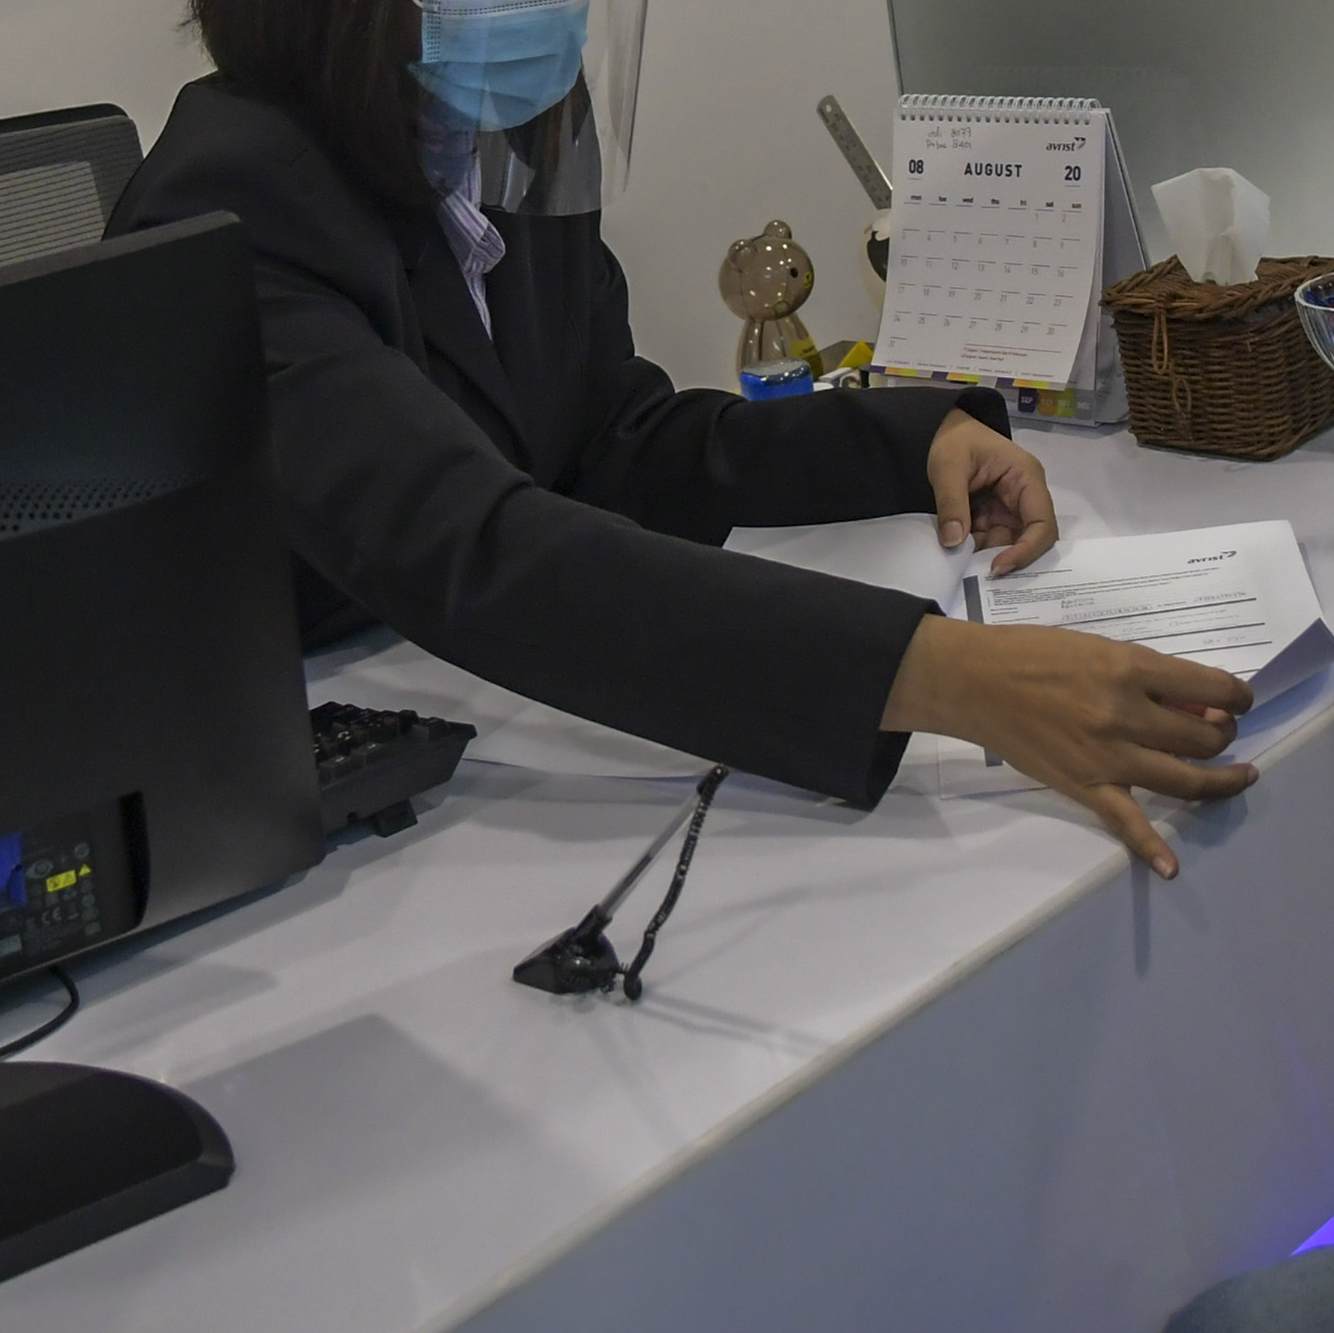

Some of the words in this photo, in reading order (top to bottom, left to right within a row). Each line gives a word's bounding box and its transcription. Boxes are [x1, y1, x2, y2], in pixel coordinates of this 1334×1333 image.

[1045, 141, 1076, 152] avrist
[908, 159, 924, 174] 08
[964, 162, 1023, 178] AUGUST
[1064, 166, 1081, 181] 20
